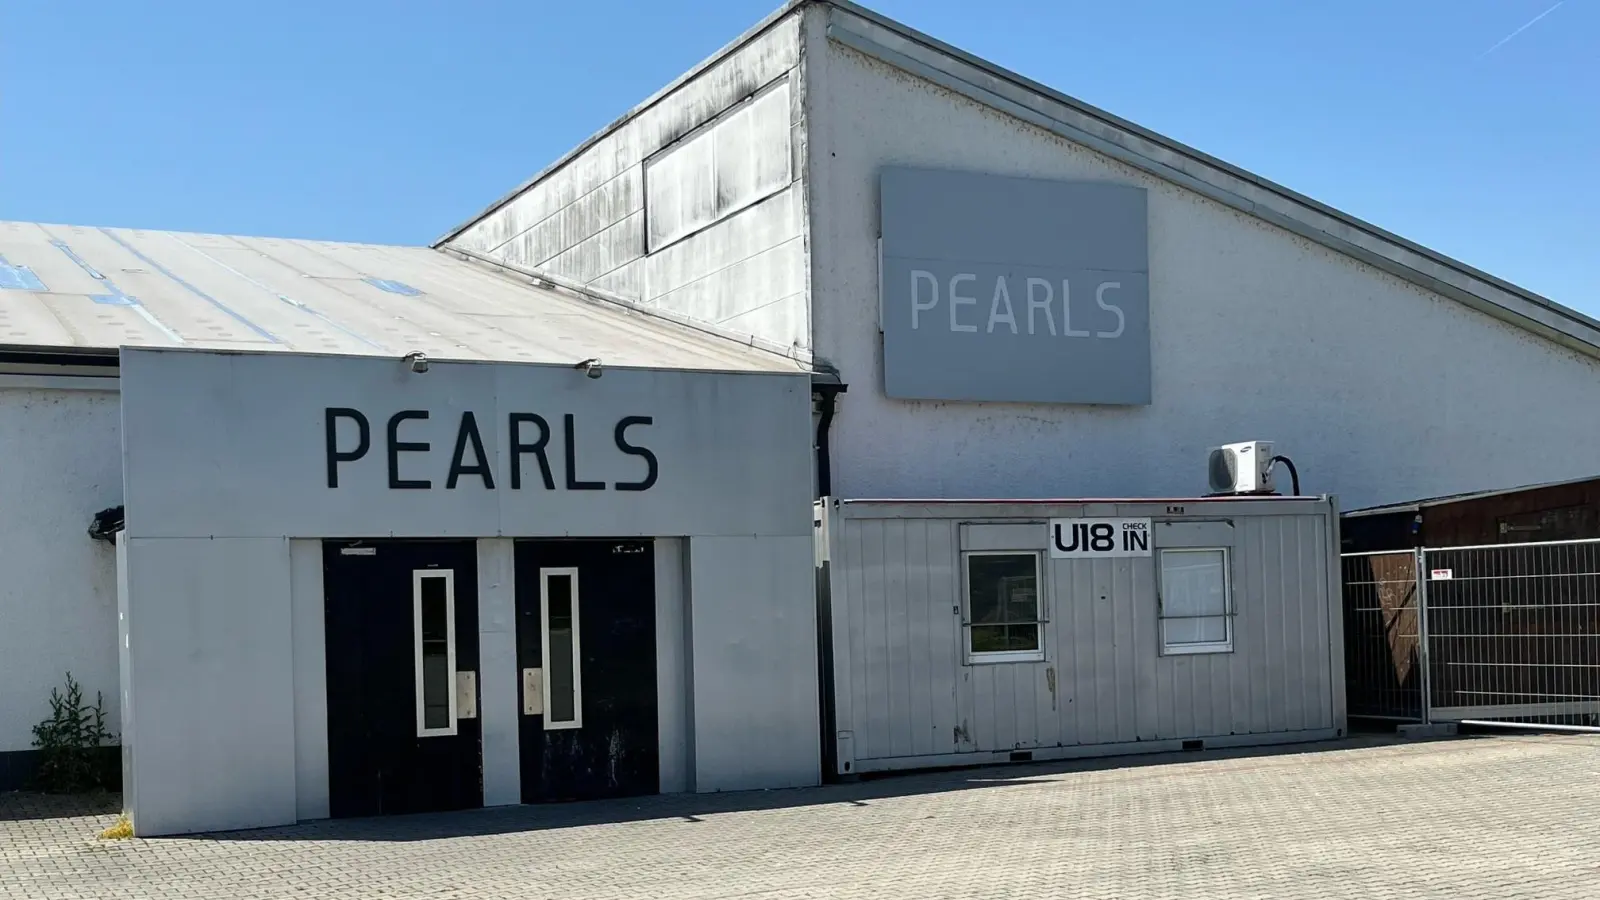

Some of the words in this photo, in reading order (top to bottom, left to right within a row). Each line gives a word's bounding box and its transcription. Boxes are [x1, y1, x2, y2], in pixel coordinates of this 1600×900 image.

[909, 269, 1126, 339] PEARLS
[325, 407, 659, 491] PEARLS
[1054, 523, 1115, 552] U18
[1122, 522, 1147, 530] CHECK
[1122, 530, 1148, 551] IN
